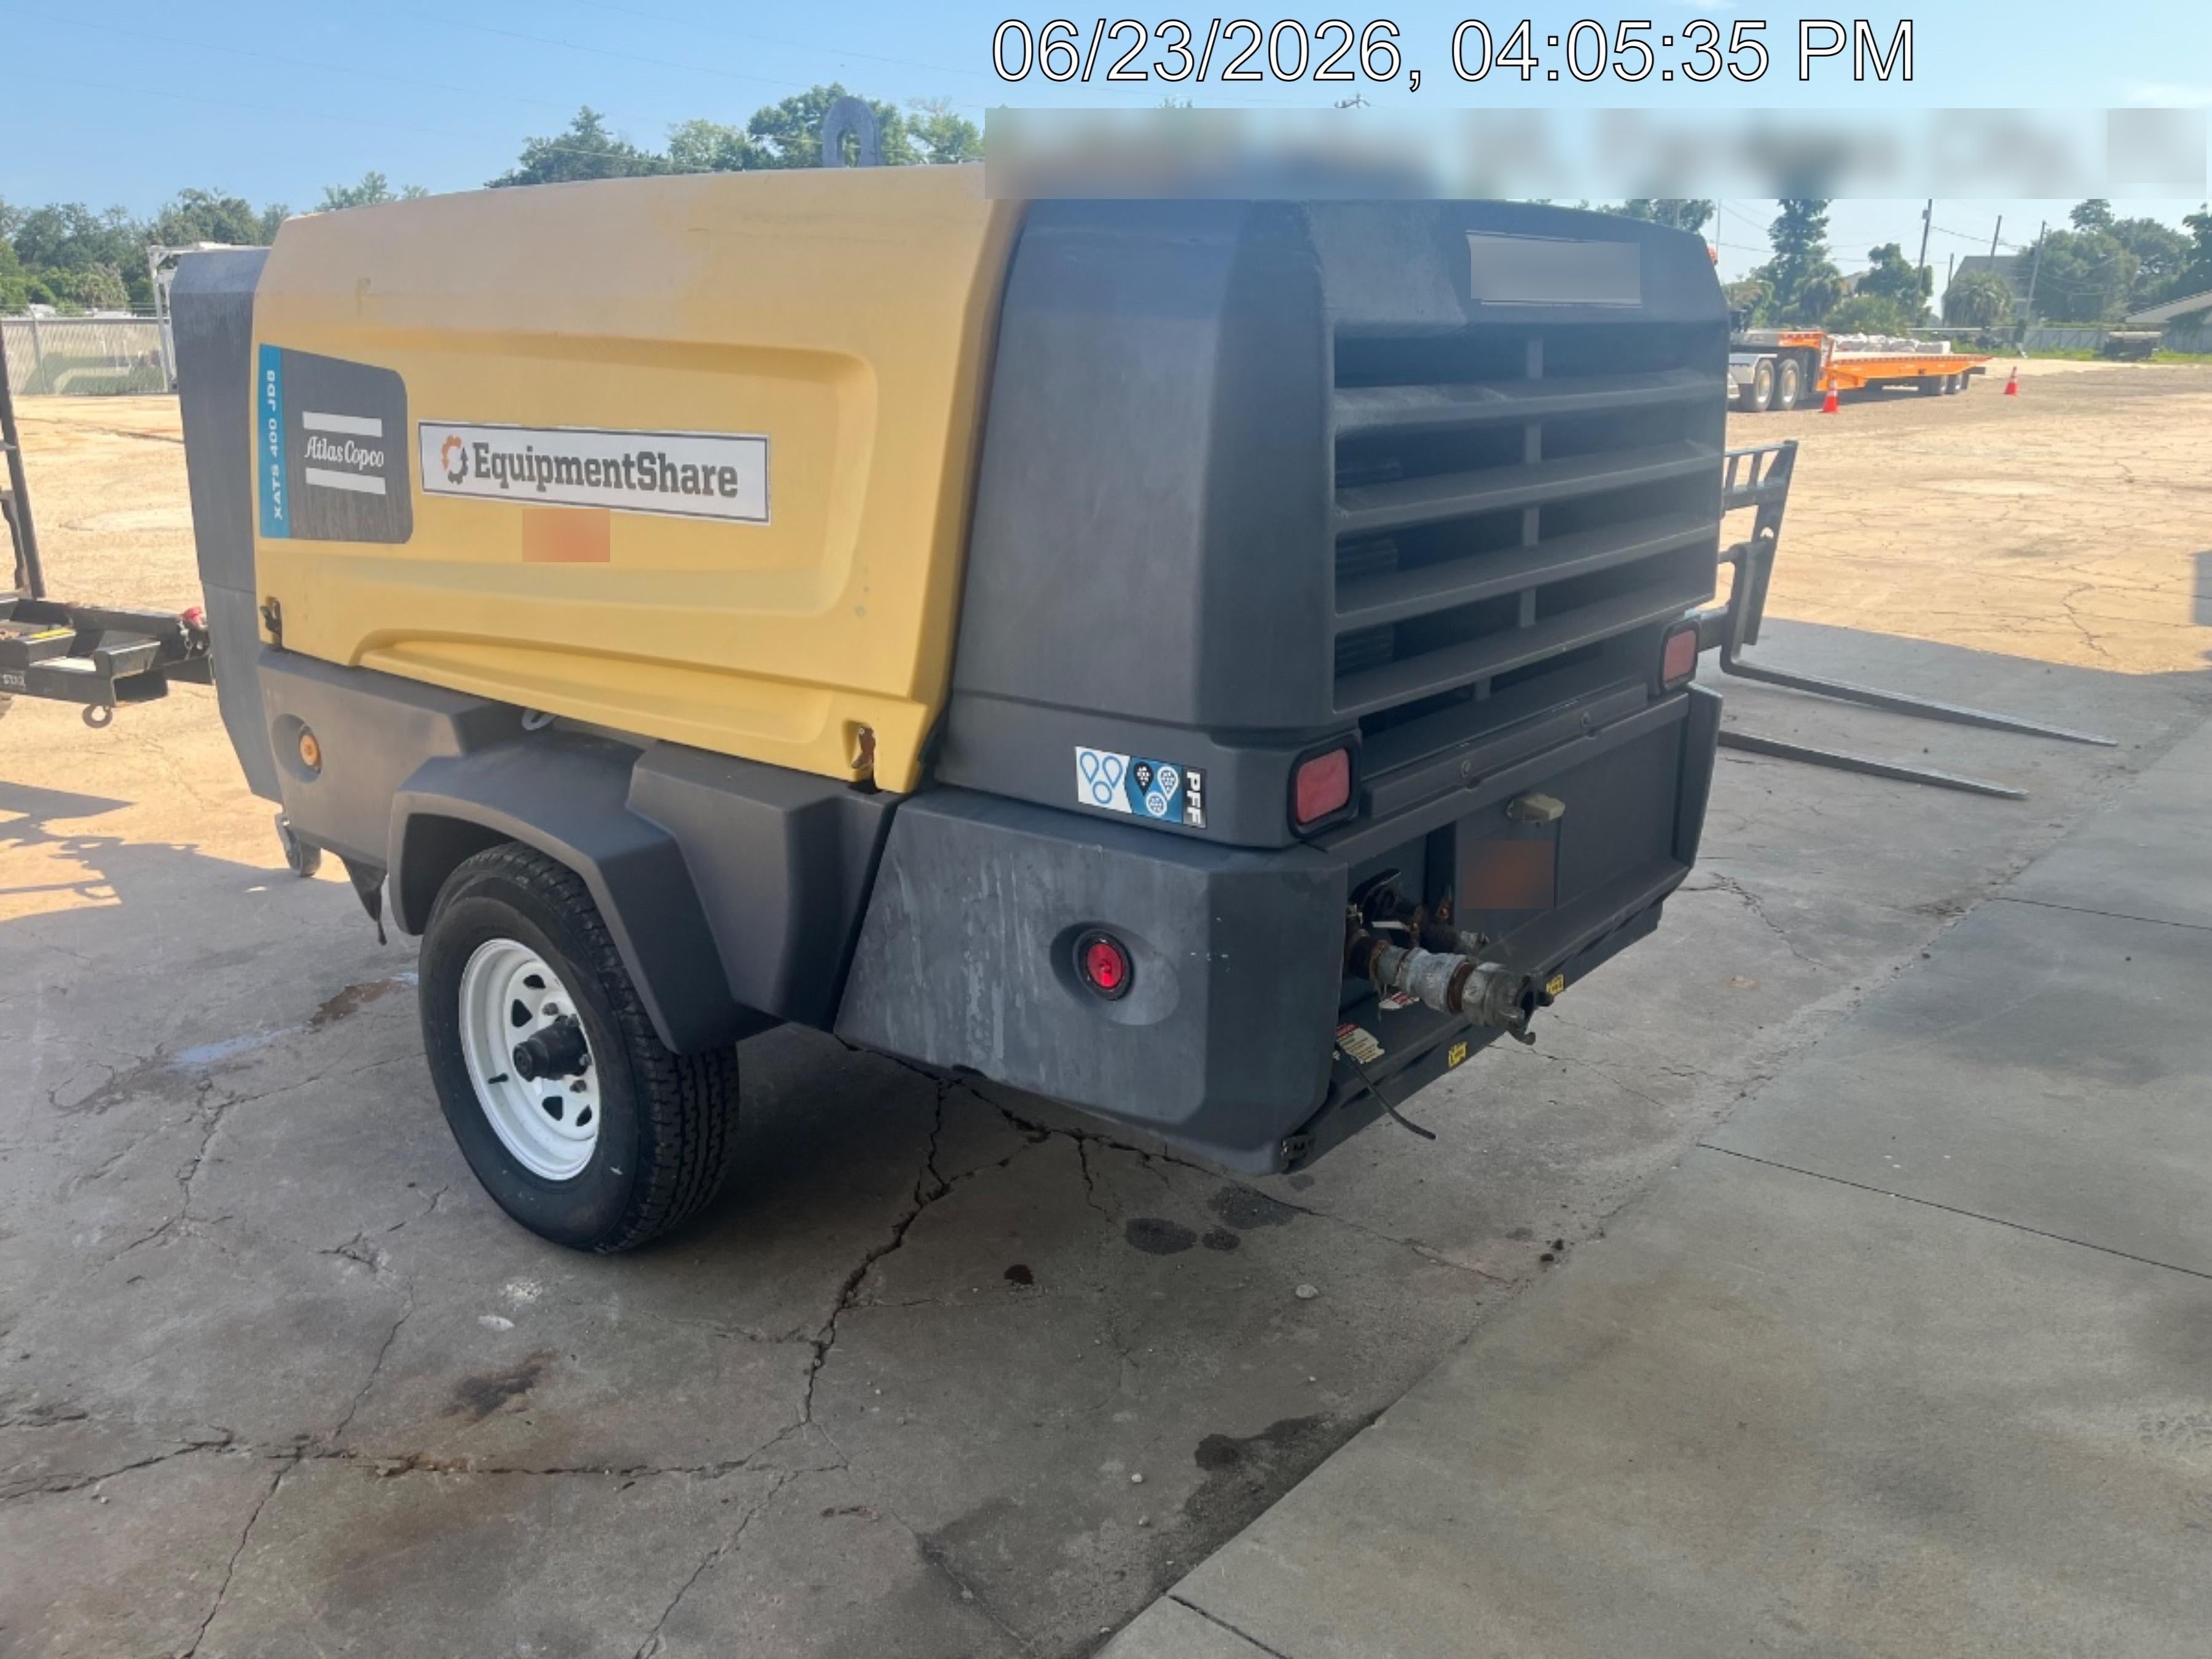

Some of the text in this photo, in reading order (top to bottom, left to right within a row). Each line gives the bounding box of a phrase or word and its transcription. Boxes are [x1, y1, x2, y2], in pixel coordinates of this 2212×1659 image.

[268, 418, 279, 458] 400
[305, 436, 384, 471] Atlas Copco
[270, 464, 283, 521] XATS
[473, 442, 739, 498] EquipmentShare
[1186, 771, 1201, 825] PFF
